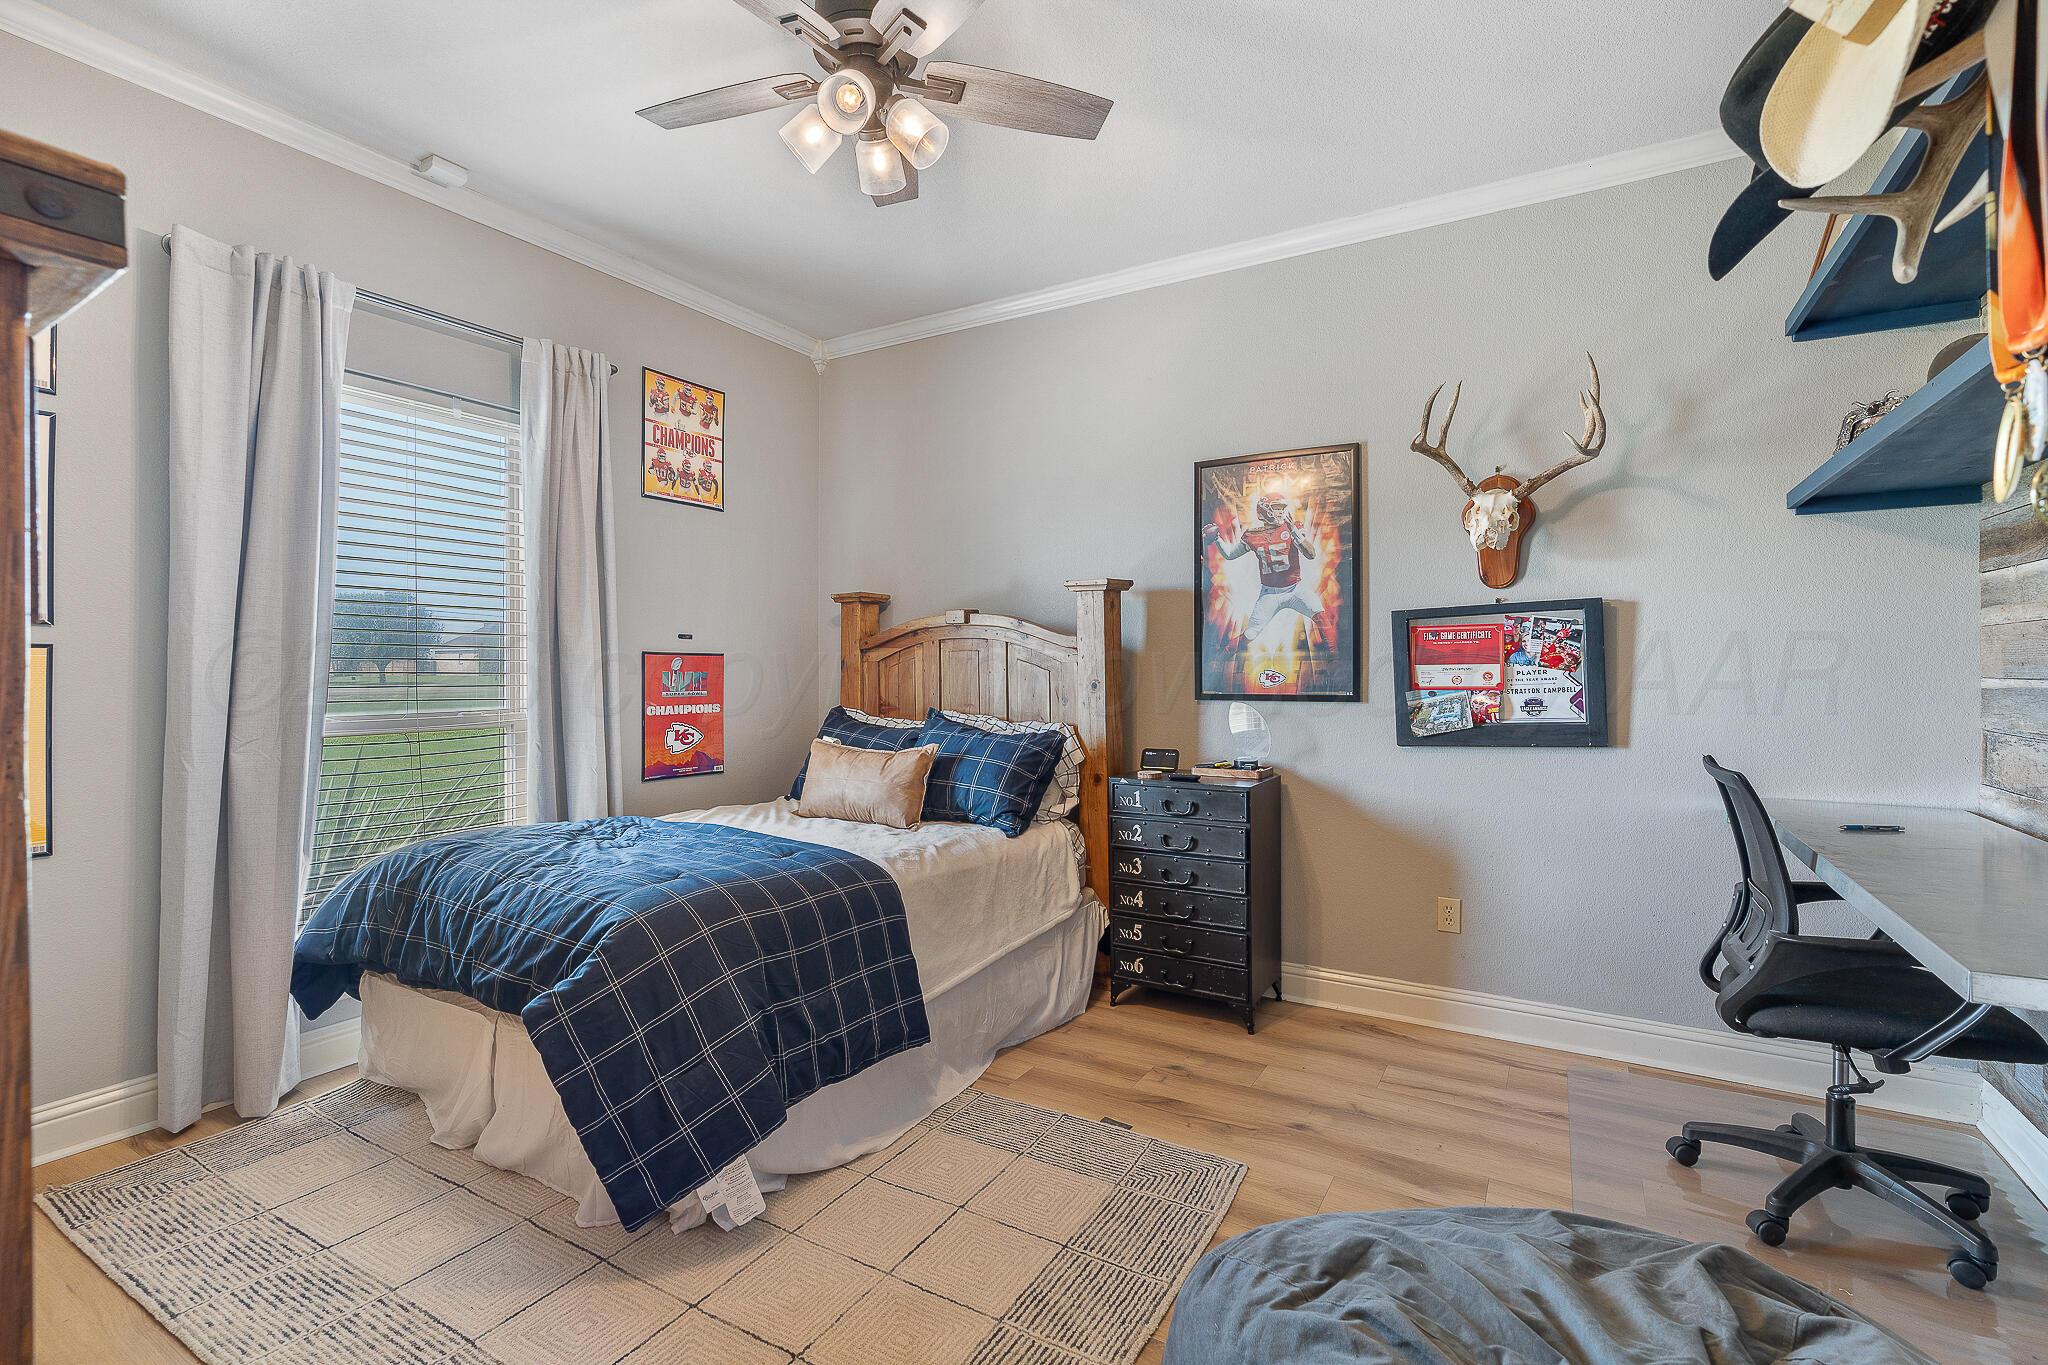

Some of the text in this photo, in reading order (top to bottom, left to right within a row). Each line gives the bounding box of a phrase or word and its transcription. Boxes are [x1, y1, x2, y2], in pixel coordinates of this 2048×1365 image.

[652, 423, 715, 458] CHAMPIONS
[1250, 463, 1296, 474] PATRICK
[1257, 543, 1291, 574] 15
[1440, 630, 1456, 640] GAME
[1456, 630, 1492, 640] CERTIFICATE
[1506, 687, 1540, 695] STRATTON
[646, 703, 721, 716] CHAMPIONS
[674, 729, 695, 745] KC
